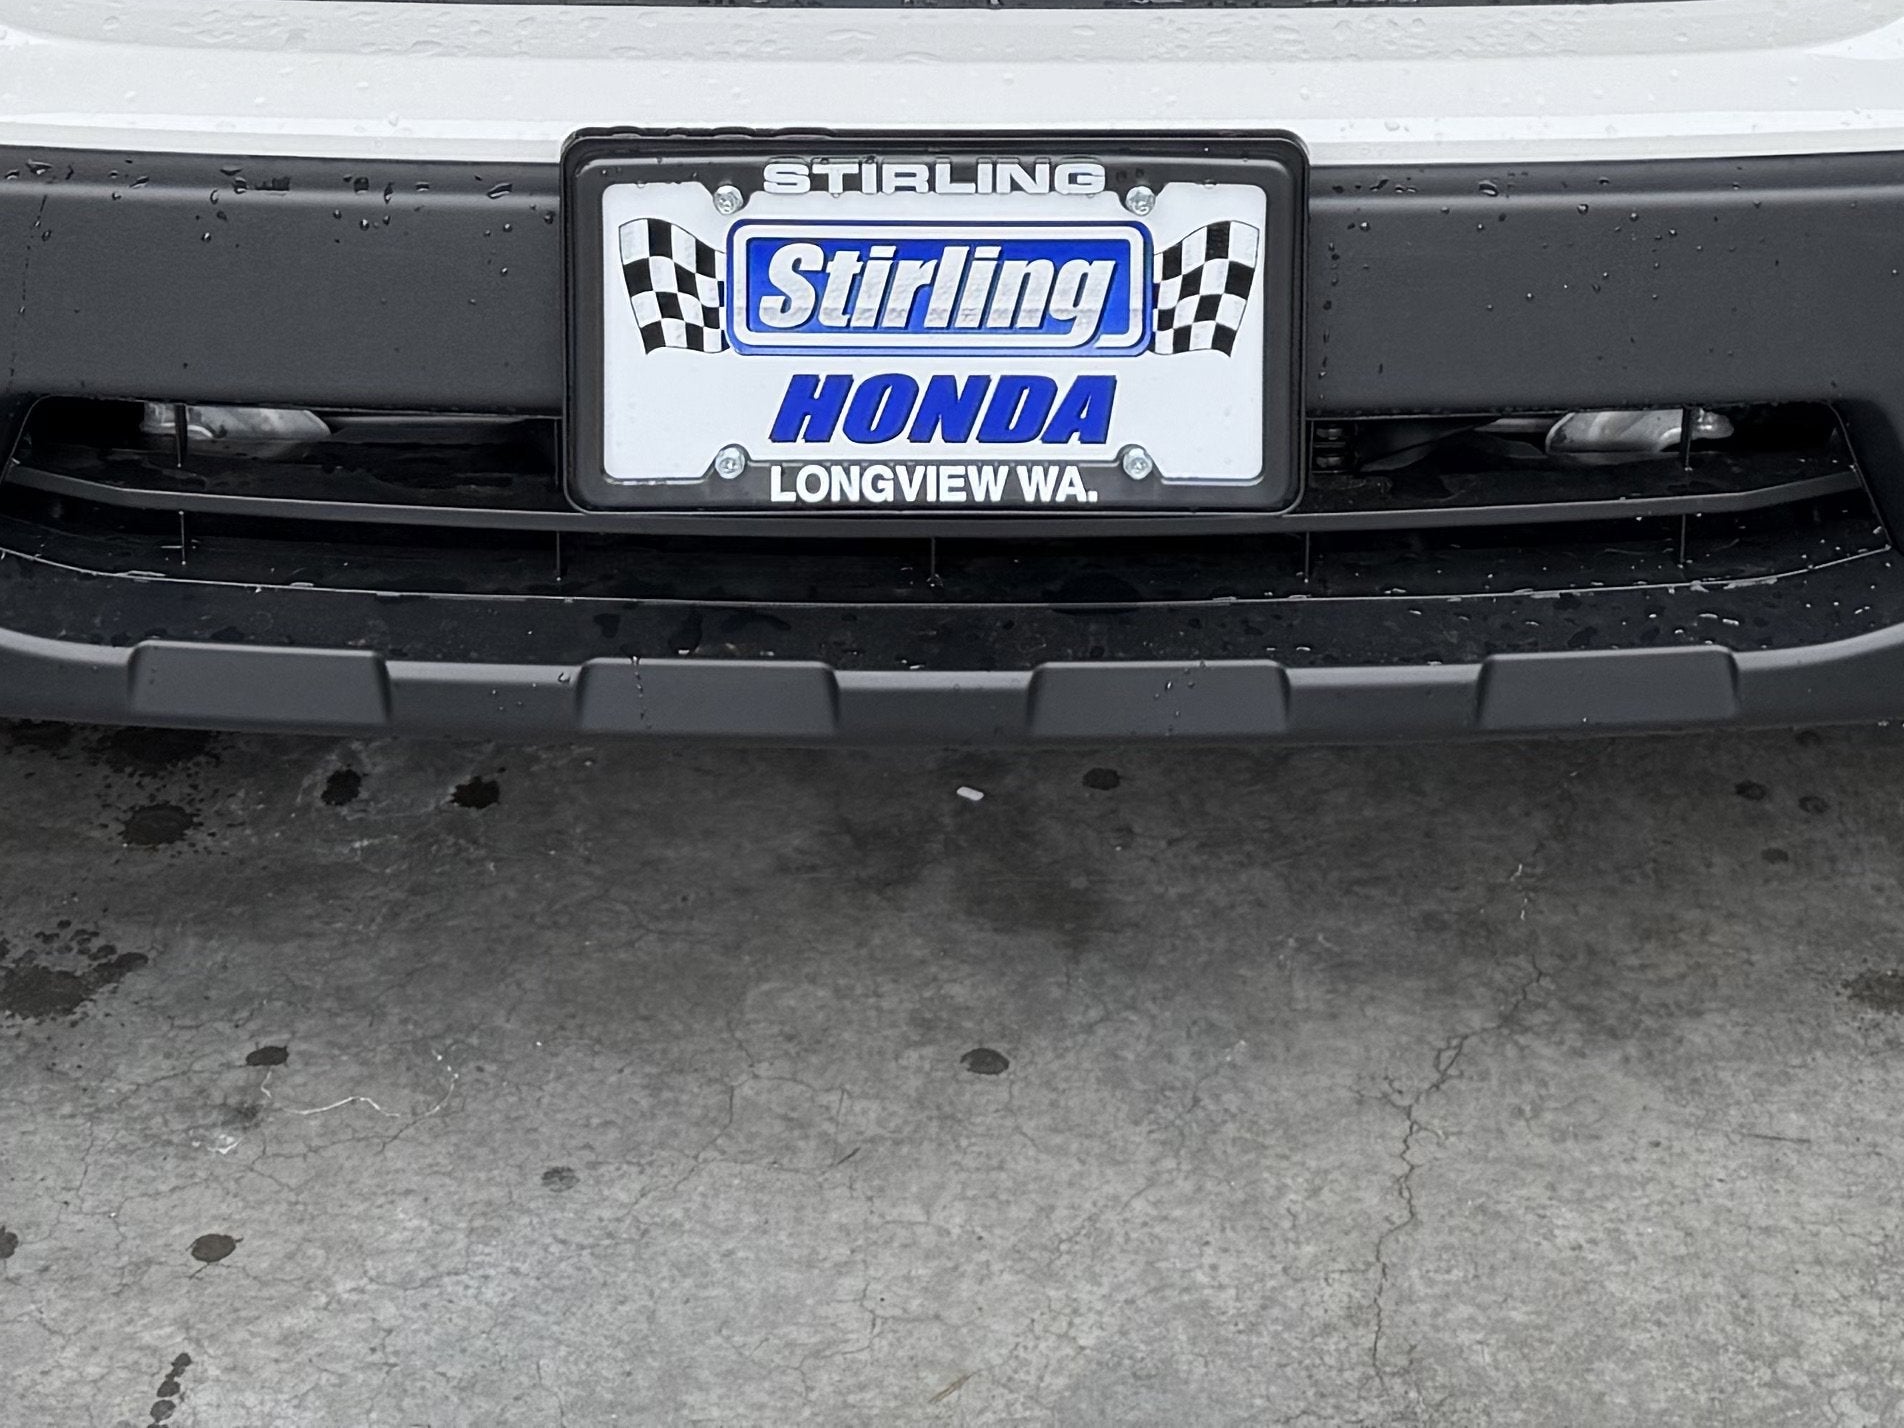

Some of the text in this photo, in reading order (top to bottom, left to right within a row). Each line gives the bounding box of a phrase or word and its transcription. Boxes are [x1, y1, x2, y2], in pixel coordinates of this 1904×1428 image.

[763, 162, 1106, 195] STIRLING
[758, 242, 1115, 344] Stirling
[768, 373, 1117, 444] HONDA
[769, 464, 1098, 503] LONGVIEW WA.
